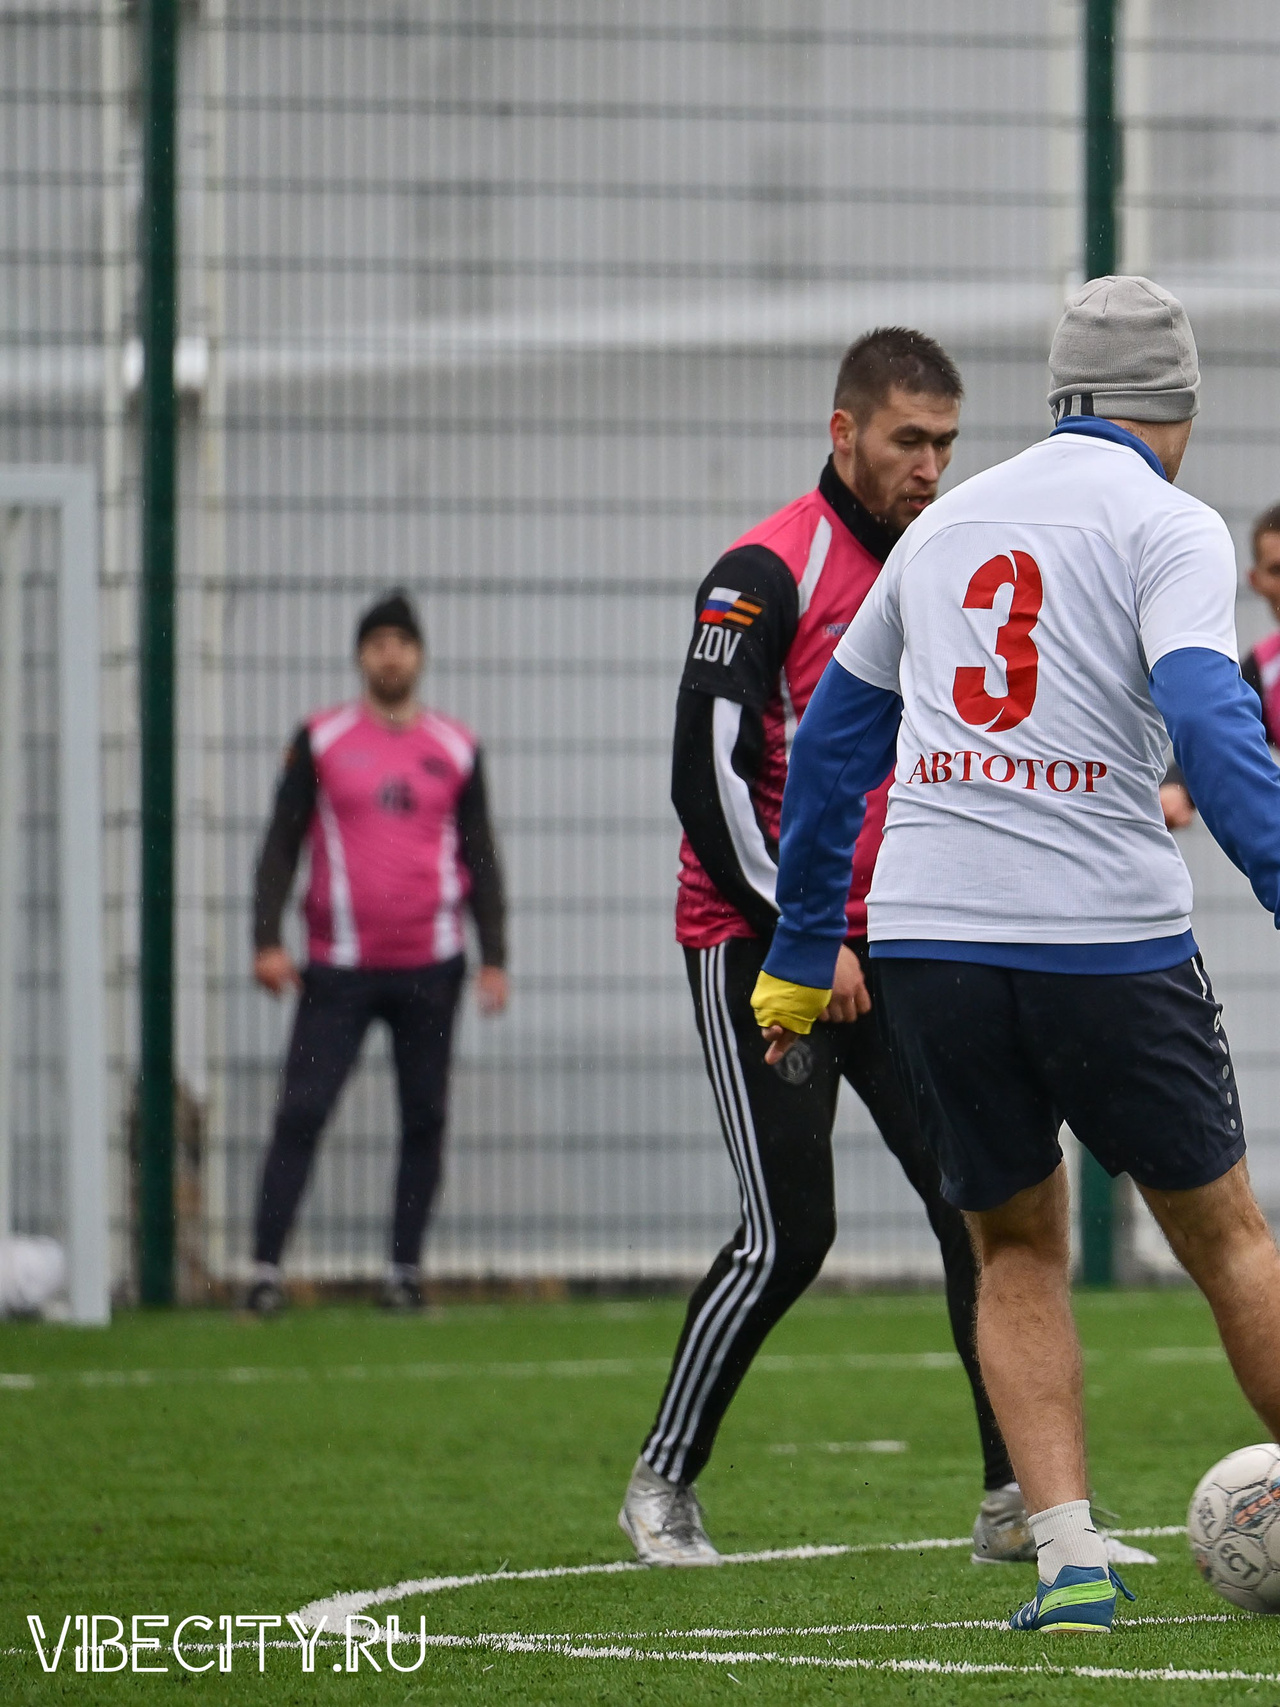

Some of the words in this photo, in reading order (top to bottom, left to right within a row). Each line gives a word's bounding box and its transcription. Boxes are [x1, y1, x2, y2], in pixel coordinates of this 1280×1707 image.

[693, 623, 742, 666] ZOV
[952, 549, 1043, 733] 3
[906, 750, 1108, 793] АВТОТОР
